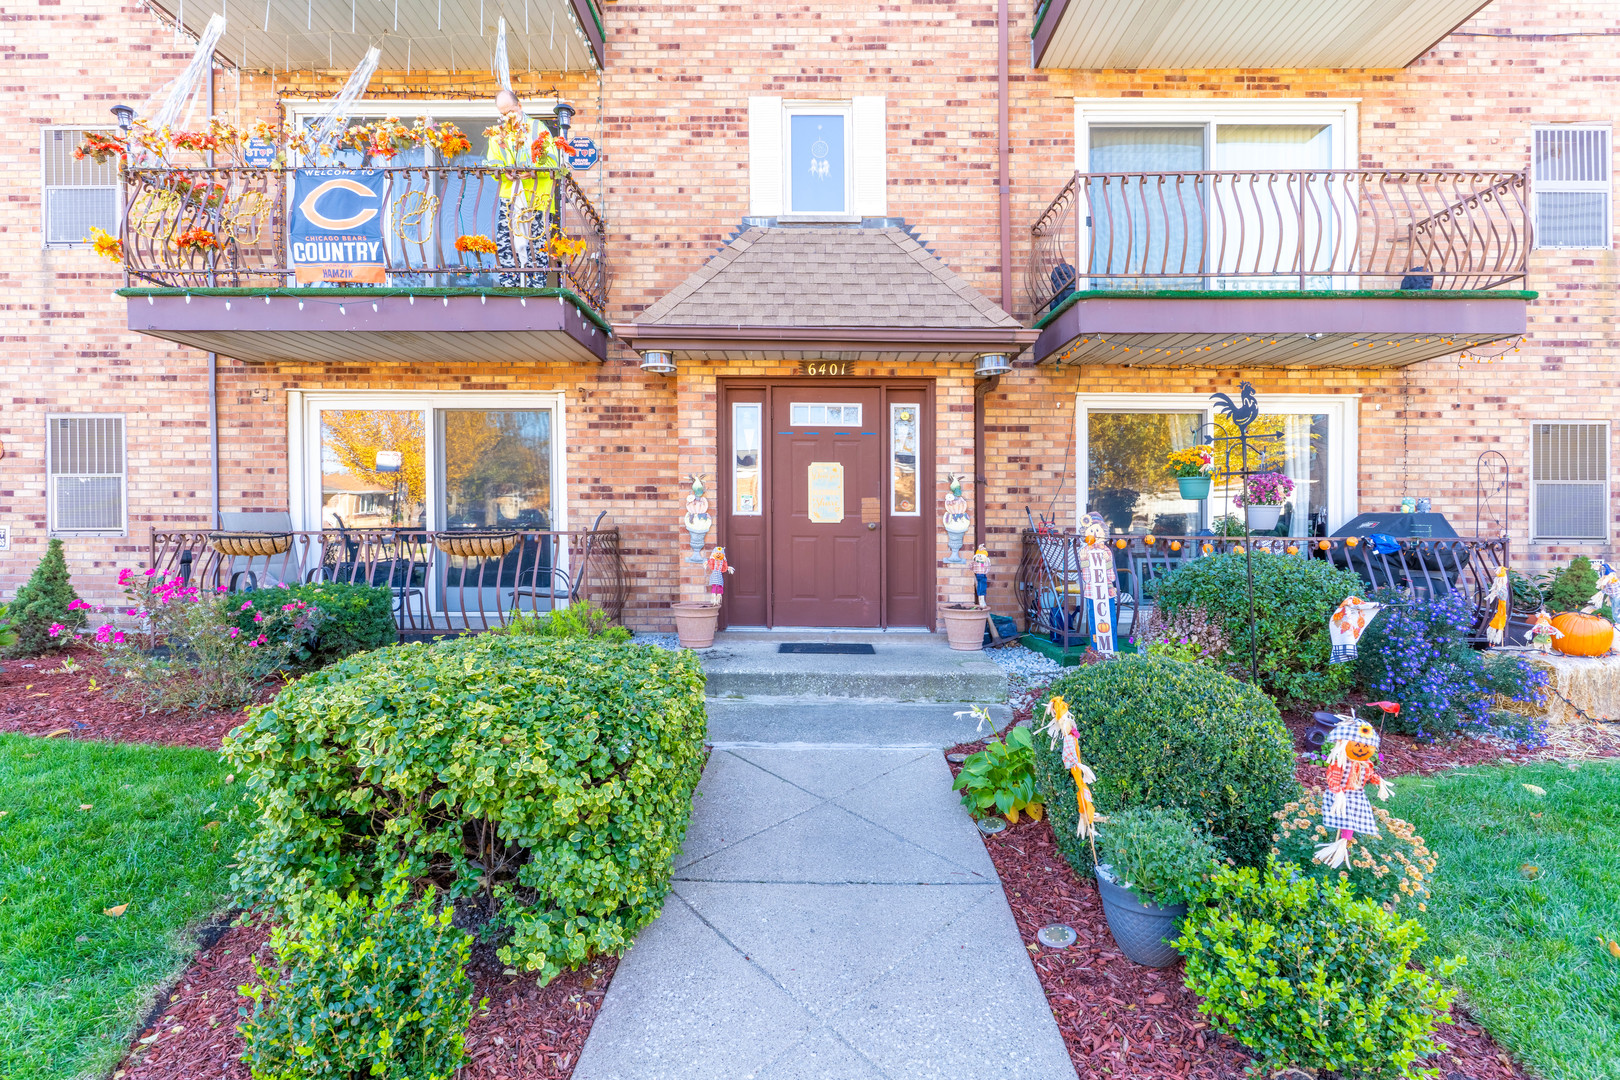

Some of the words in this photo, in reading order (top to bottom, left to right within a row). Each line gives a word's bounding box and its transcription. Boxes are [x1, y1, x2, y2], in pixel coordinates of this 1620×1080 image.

[246, 148, 274, 156] STOP
[569, 148, 596, 156] TOP
[293, 241, 380, 262] COUNTRY
[808, 362, 846, 376] 6401
